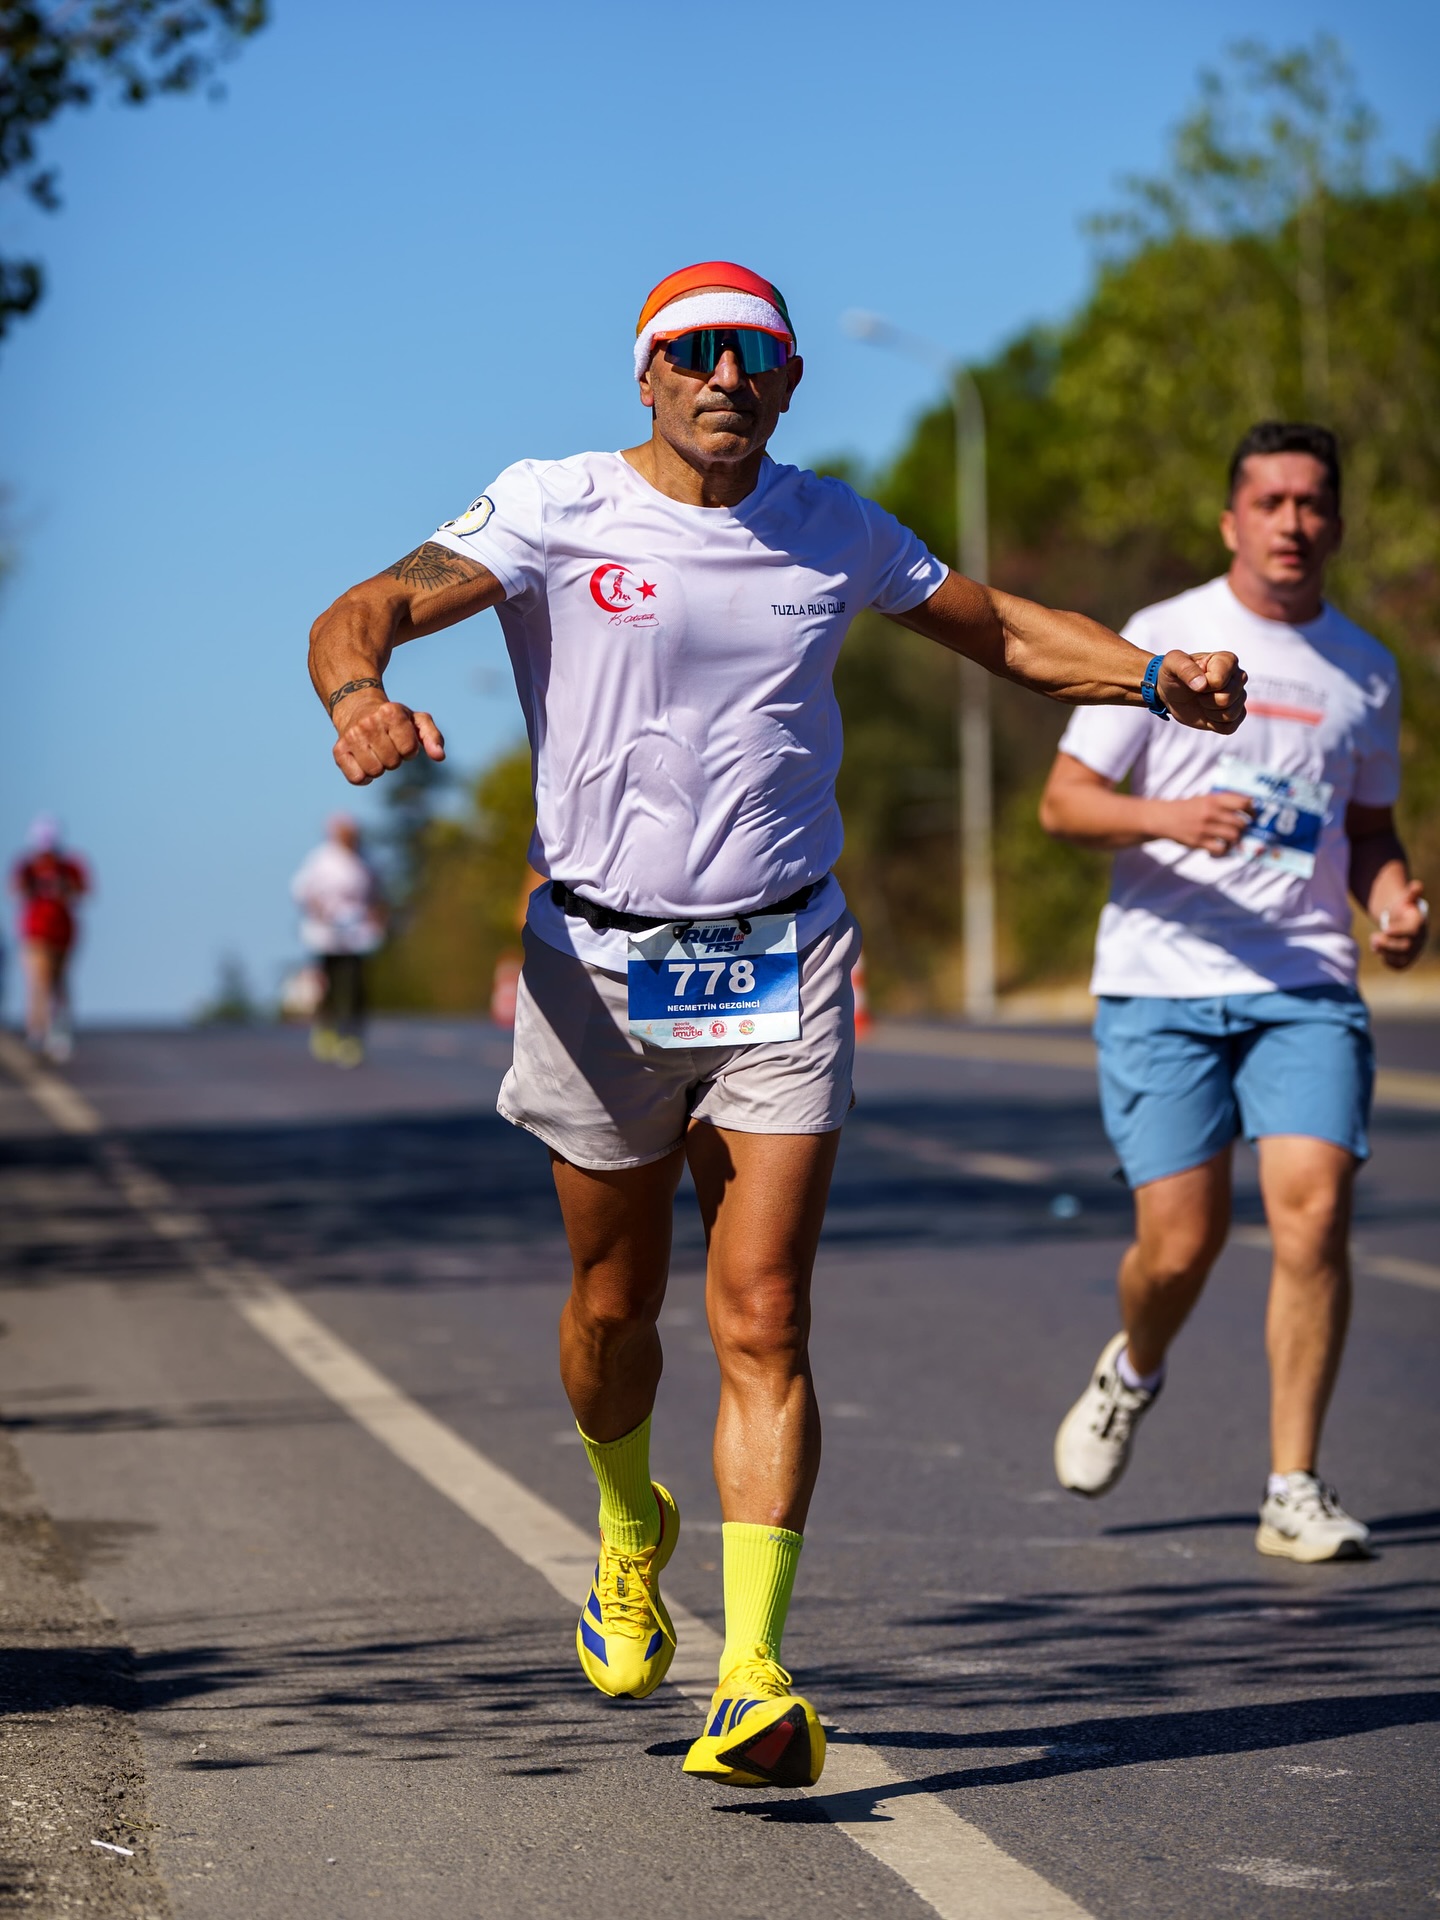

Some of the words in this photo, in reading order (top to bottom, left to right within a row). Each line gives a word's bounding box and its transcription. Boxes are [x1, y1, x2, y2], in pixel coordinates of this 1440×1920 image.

[771, 604, 806, 616] TUZLA
[807, 603, 827, 615] RUN
[828, 602, 846, 614] CLUB
[681, 927, 737, 944] RUN
[733, 934, 746, 942] 10K
[705, 941, 744, 954] FEST
[668, 960, 756, 997] 778
[667, 1002, 717, 1012] NECMETTİN
[719, 1000, 760, 1010] GEZGİNCİ
[673, 1029, 703, 1037] umutla
